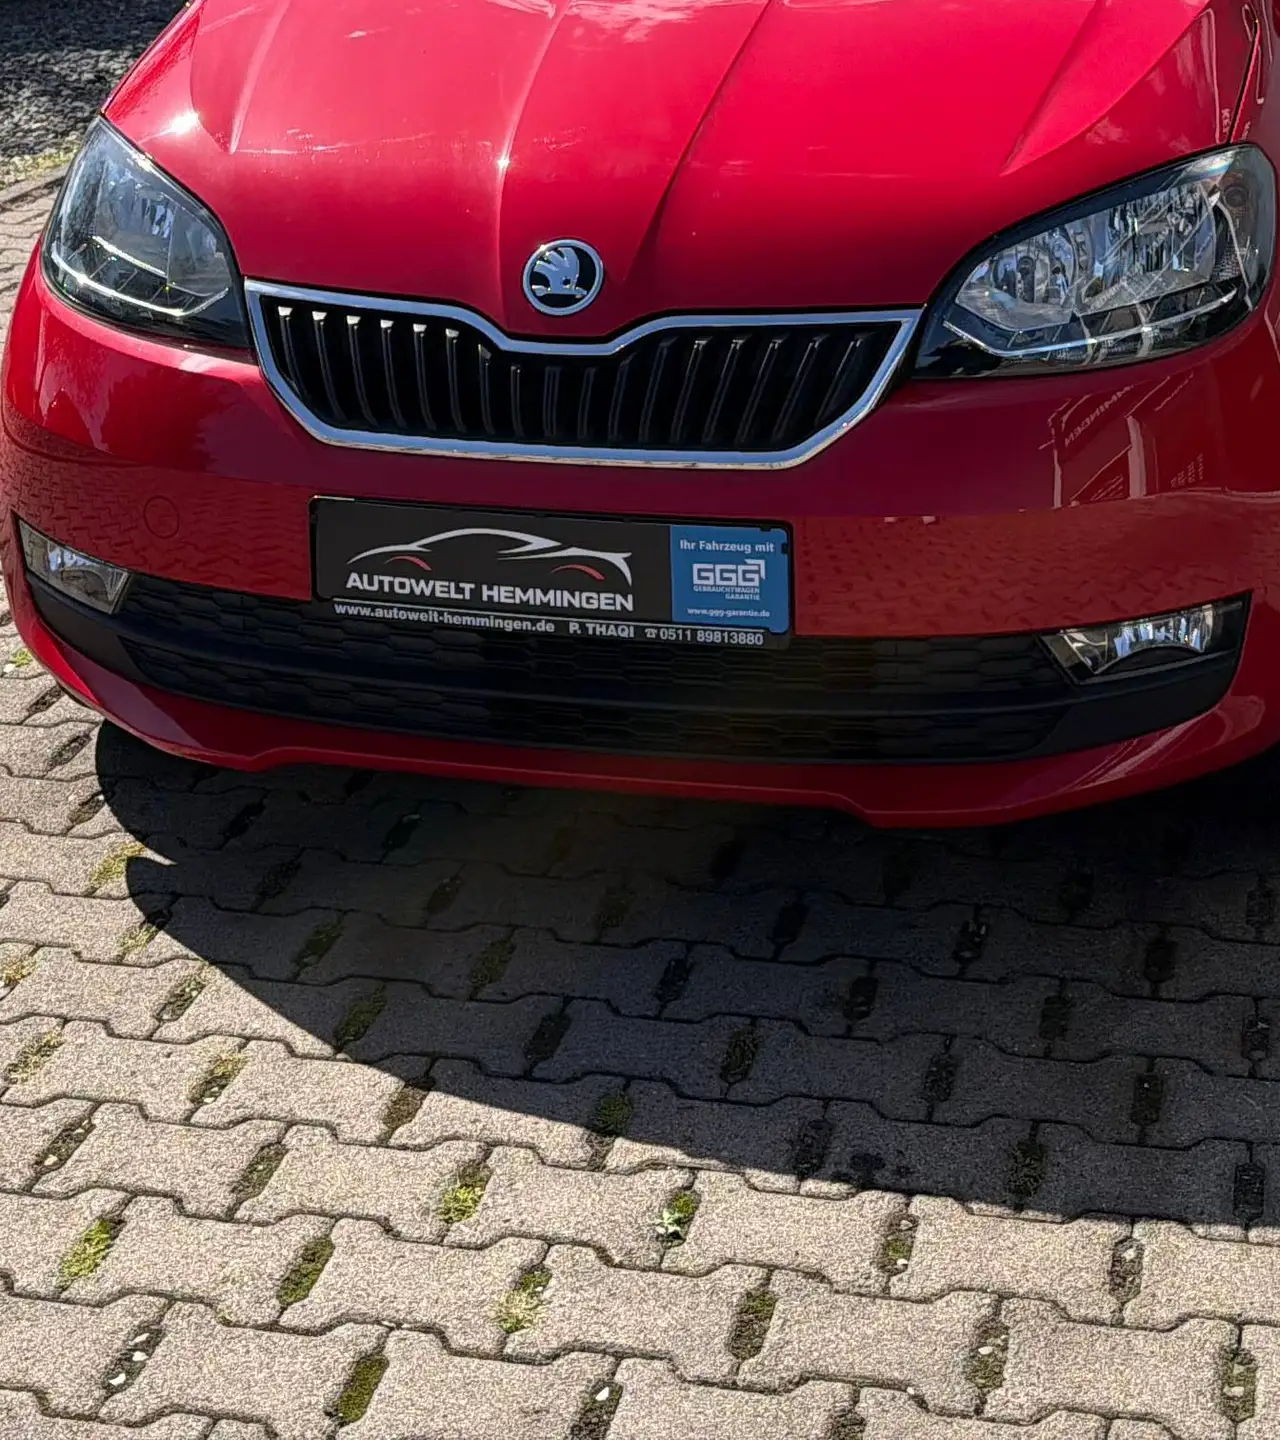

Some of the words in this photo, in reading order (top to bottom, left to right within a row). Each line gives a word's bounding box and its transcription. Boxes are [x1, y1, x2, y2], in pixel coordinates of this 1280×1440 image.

[680, 540, 696, 550] Ihr
[699, 540, 752, 554] Fahrzeug
[755, 542, 775, 553] mit
[692, 563, 760, 587] GGG
[346, 572, 475, 600] AUTOWELT
[482, 583, 634, 612] HEMMINGEN
[693, 585, 761, 594] GEBRAUCHTWAGEN
[687, 607, 771, 618] www.ggg-garantie.de
[334, 603, 555, 633] www.autowelt-hemmingen.de
[569, 622, 581, 635] P.
[587, 623, 635, 639] THAQI
[660, 627, 692, 641] 0511
[696, 628, 764, 646] 89813880
